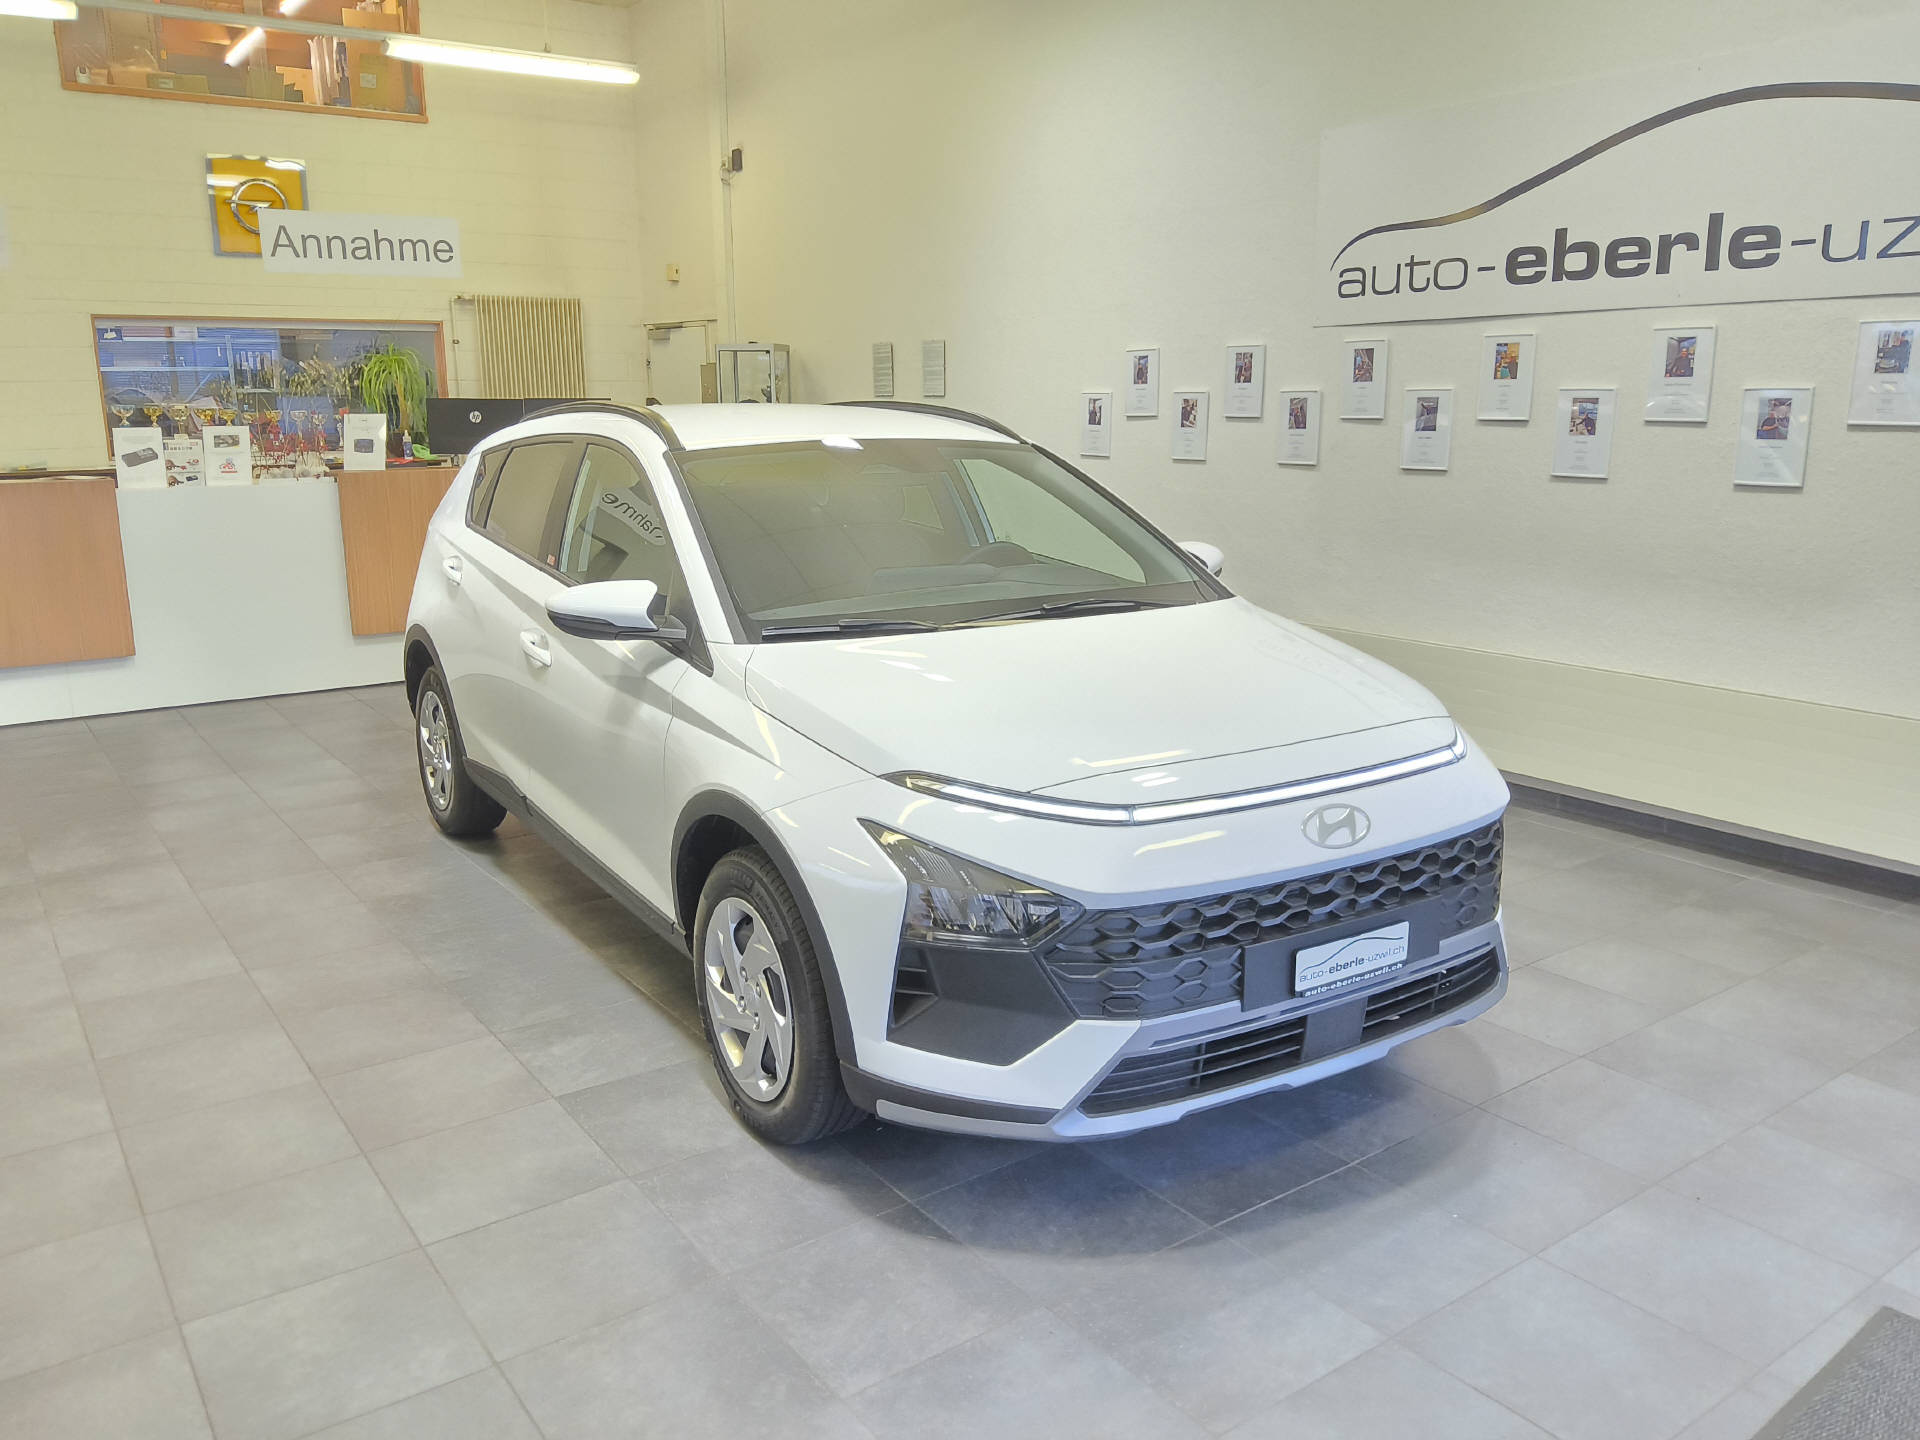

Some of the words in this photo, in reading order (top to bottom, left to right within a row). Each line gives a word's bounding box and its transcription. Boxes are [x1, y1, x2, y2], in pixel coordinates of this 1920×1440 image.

[270, 225, 454, 263] Annahme
[1337, 212, 1920, 299] auto-eberle-uz
[470, 411, 482, 423] hp
[1299, 945, 1405, 983] auto-eberle-uzwil.ch
[1304, 962, 1403, 997] auto-eberle-uzwil.ch
